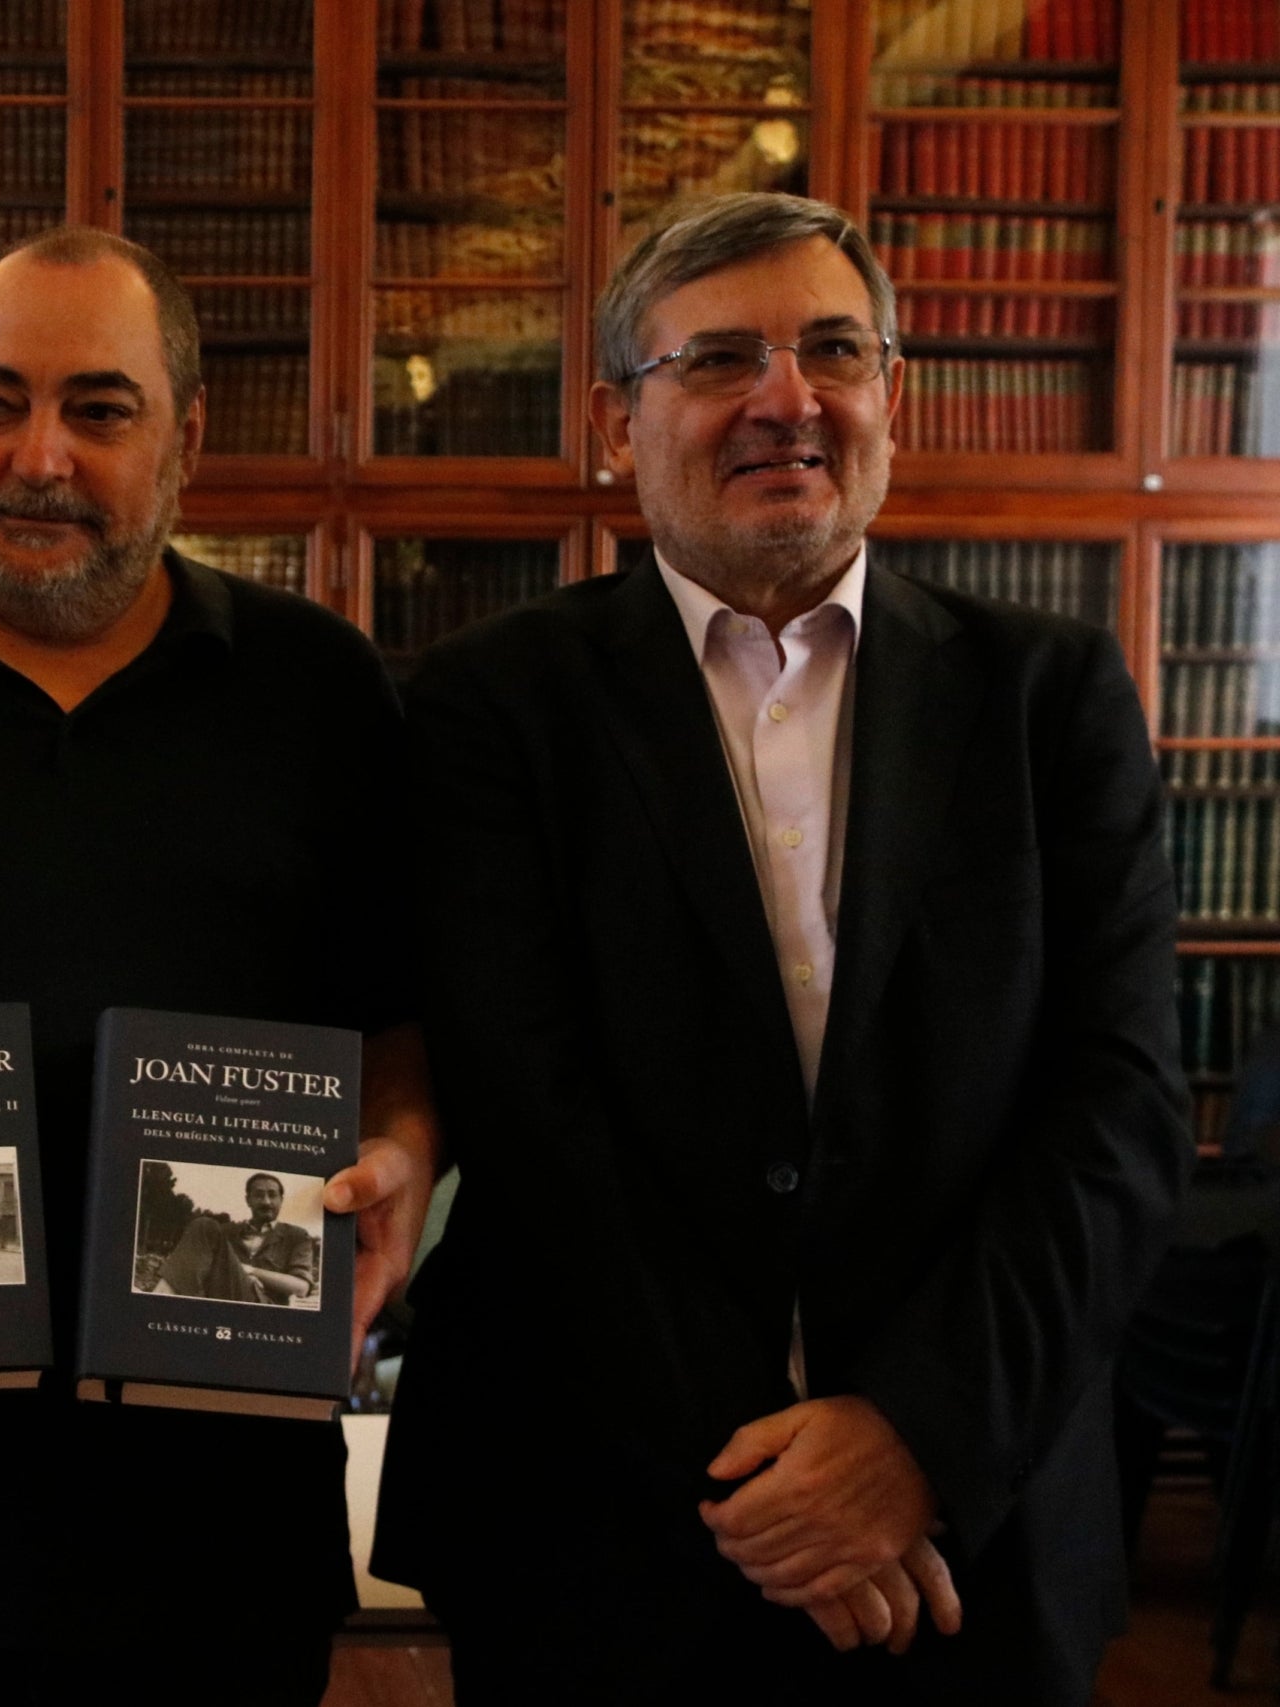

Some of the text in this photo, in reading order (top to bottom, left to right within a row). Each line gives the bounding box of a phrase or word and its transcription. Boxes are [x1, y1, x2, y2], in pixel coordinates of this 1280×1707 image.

[187, 1043, 293, 1060] OBRA COMPLETA DE
[129, 1057, 342, 1099] JOAN FUSTER
[6, 1100, 18, 1111] II
[131, 1108, 339, 1140] LLENGUA I LITERATURA, I
[143, 1127, 326, 1156] DELS ORÍGENS A LA RENAIXENÇA
[147, 1321, 303, 1344] CLÀSSICS 62 CATALANS
